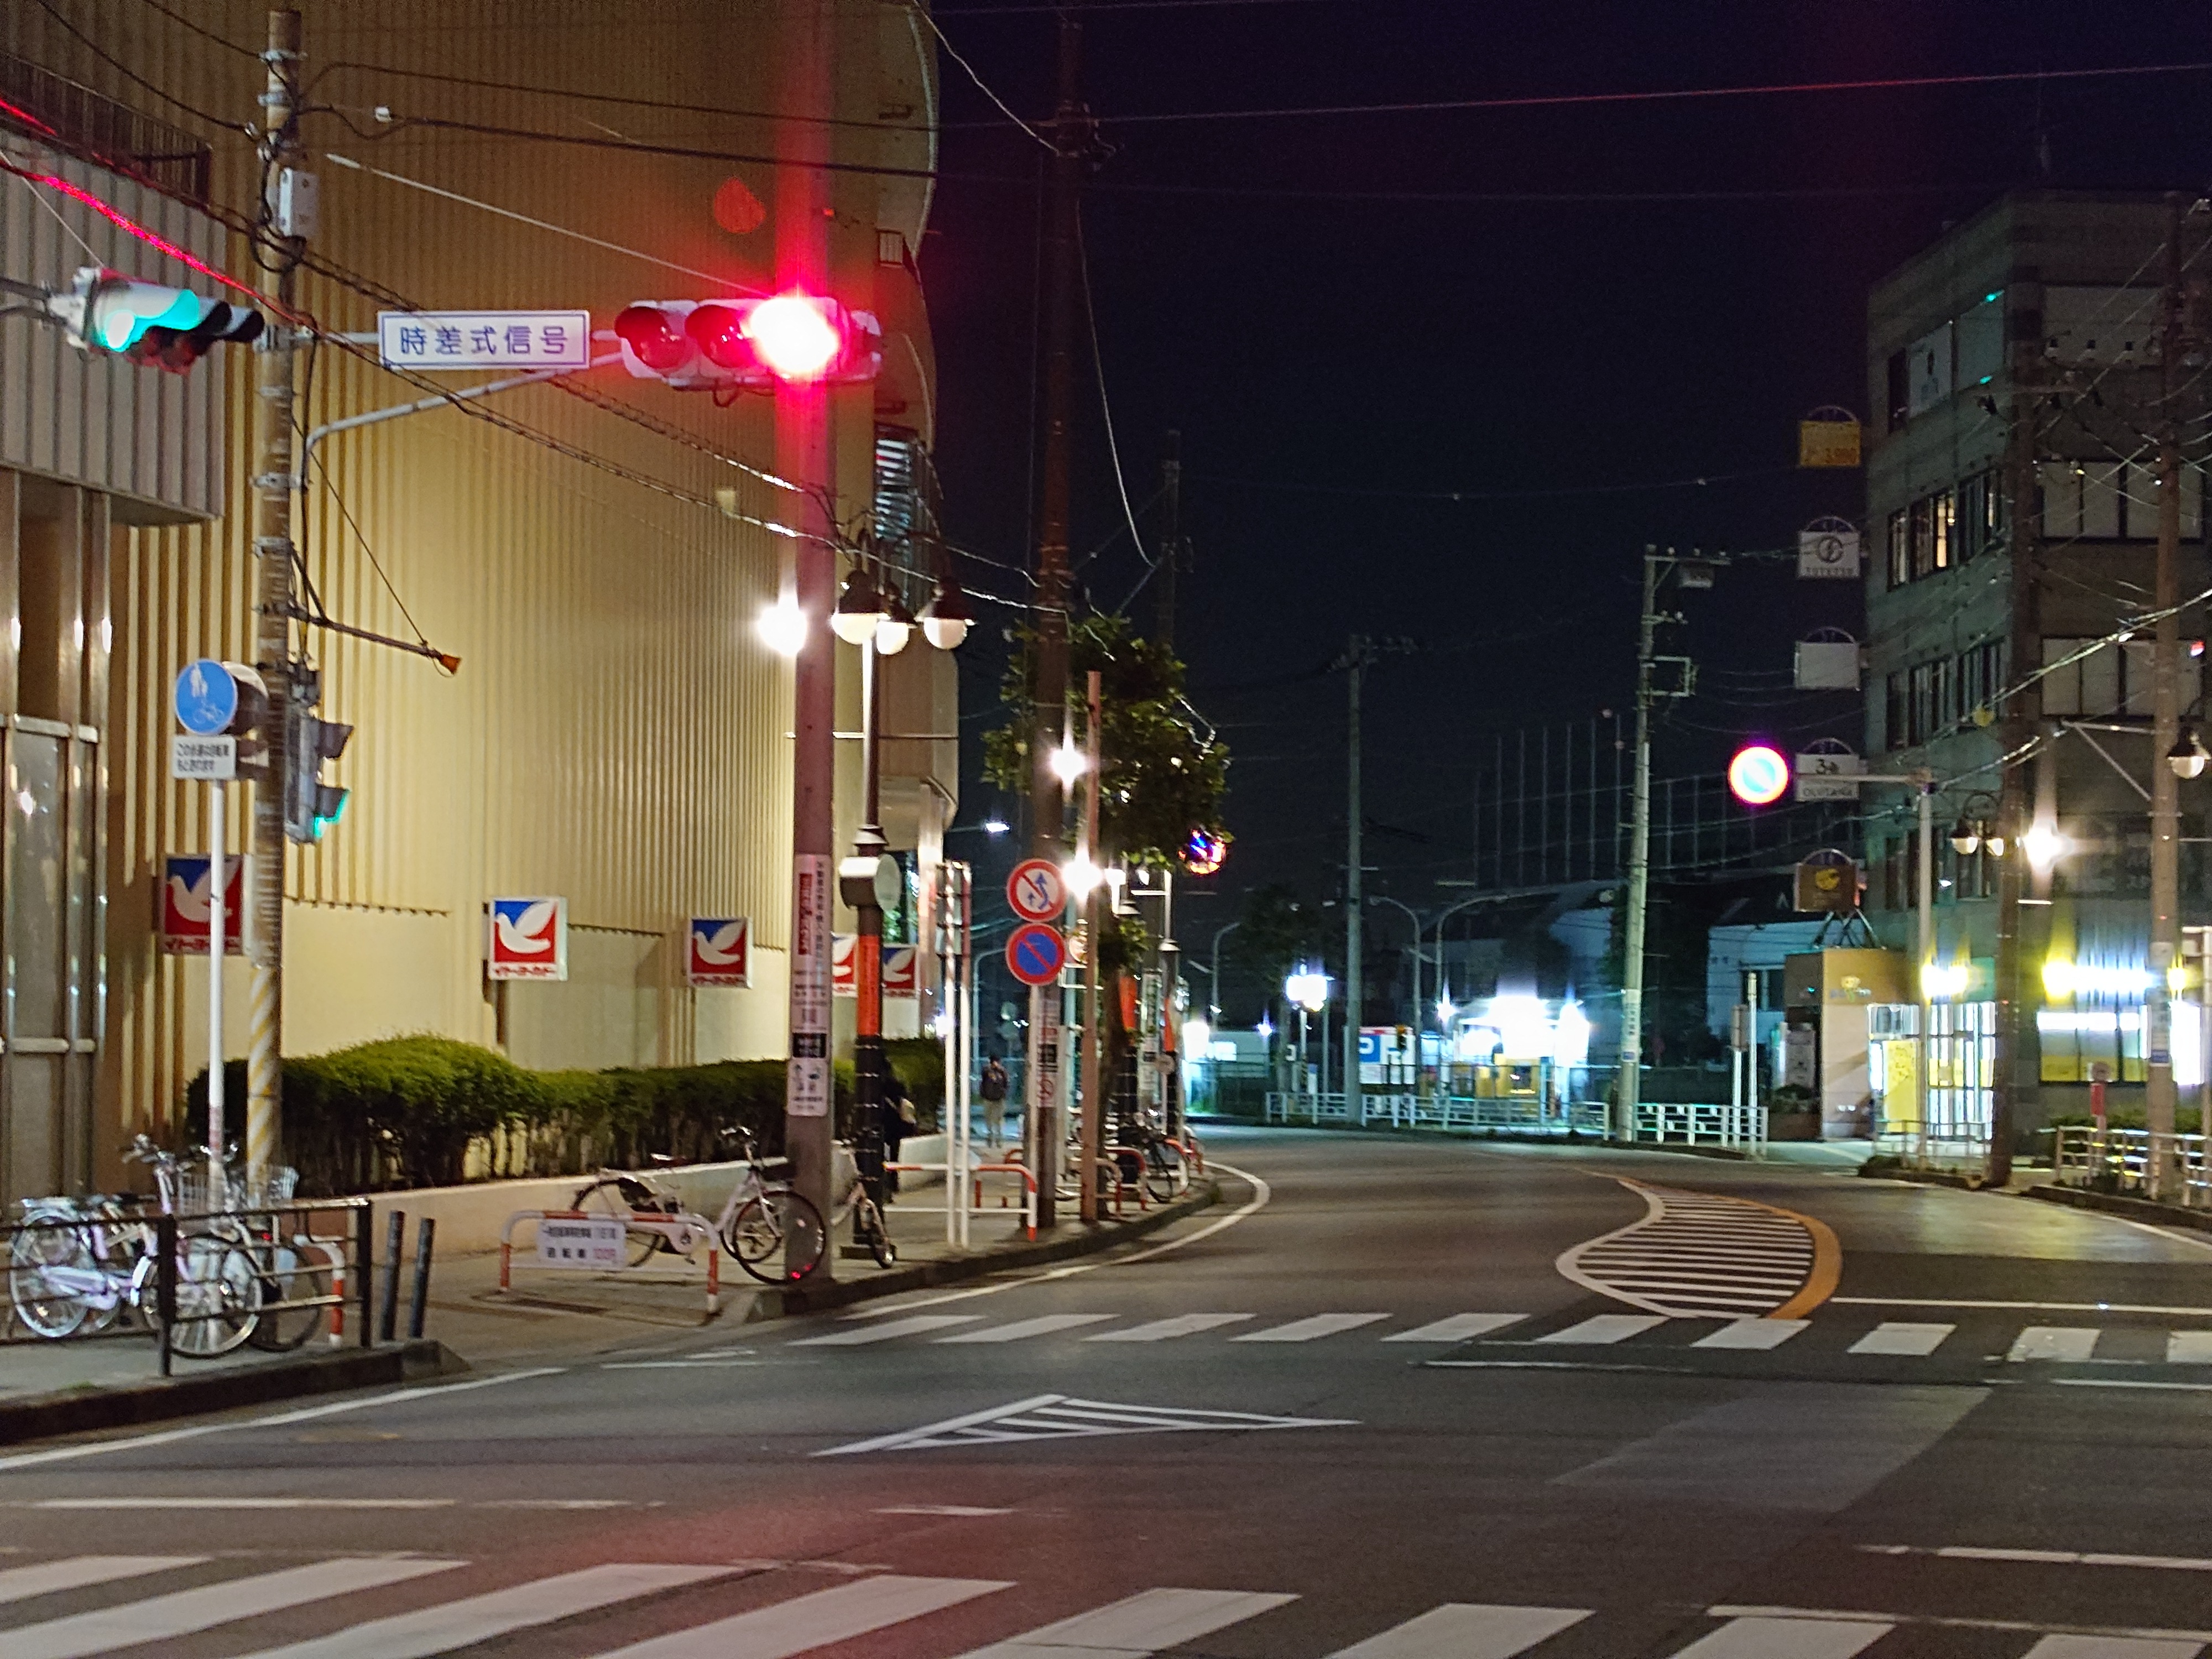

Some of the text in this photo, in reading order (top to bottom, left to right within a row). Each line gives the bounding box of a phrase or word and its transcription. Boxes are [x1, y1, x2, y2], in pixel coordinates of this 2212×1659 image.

[399, 325, 567, 355] 時差式信号
